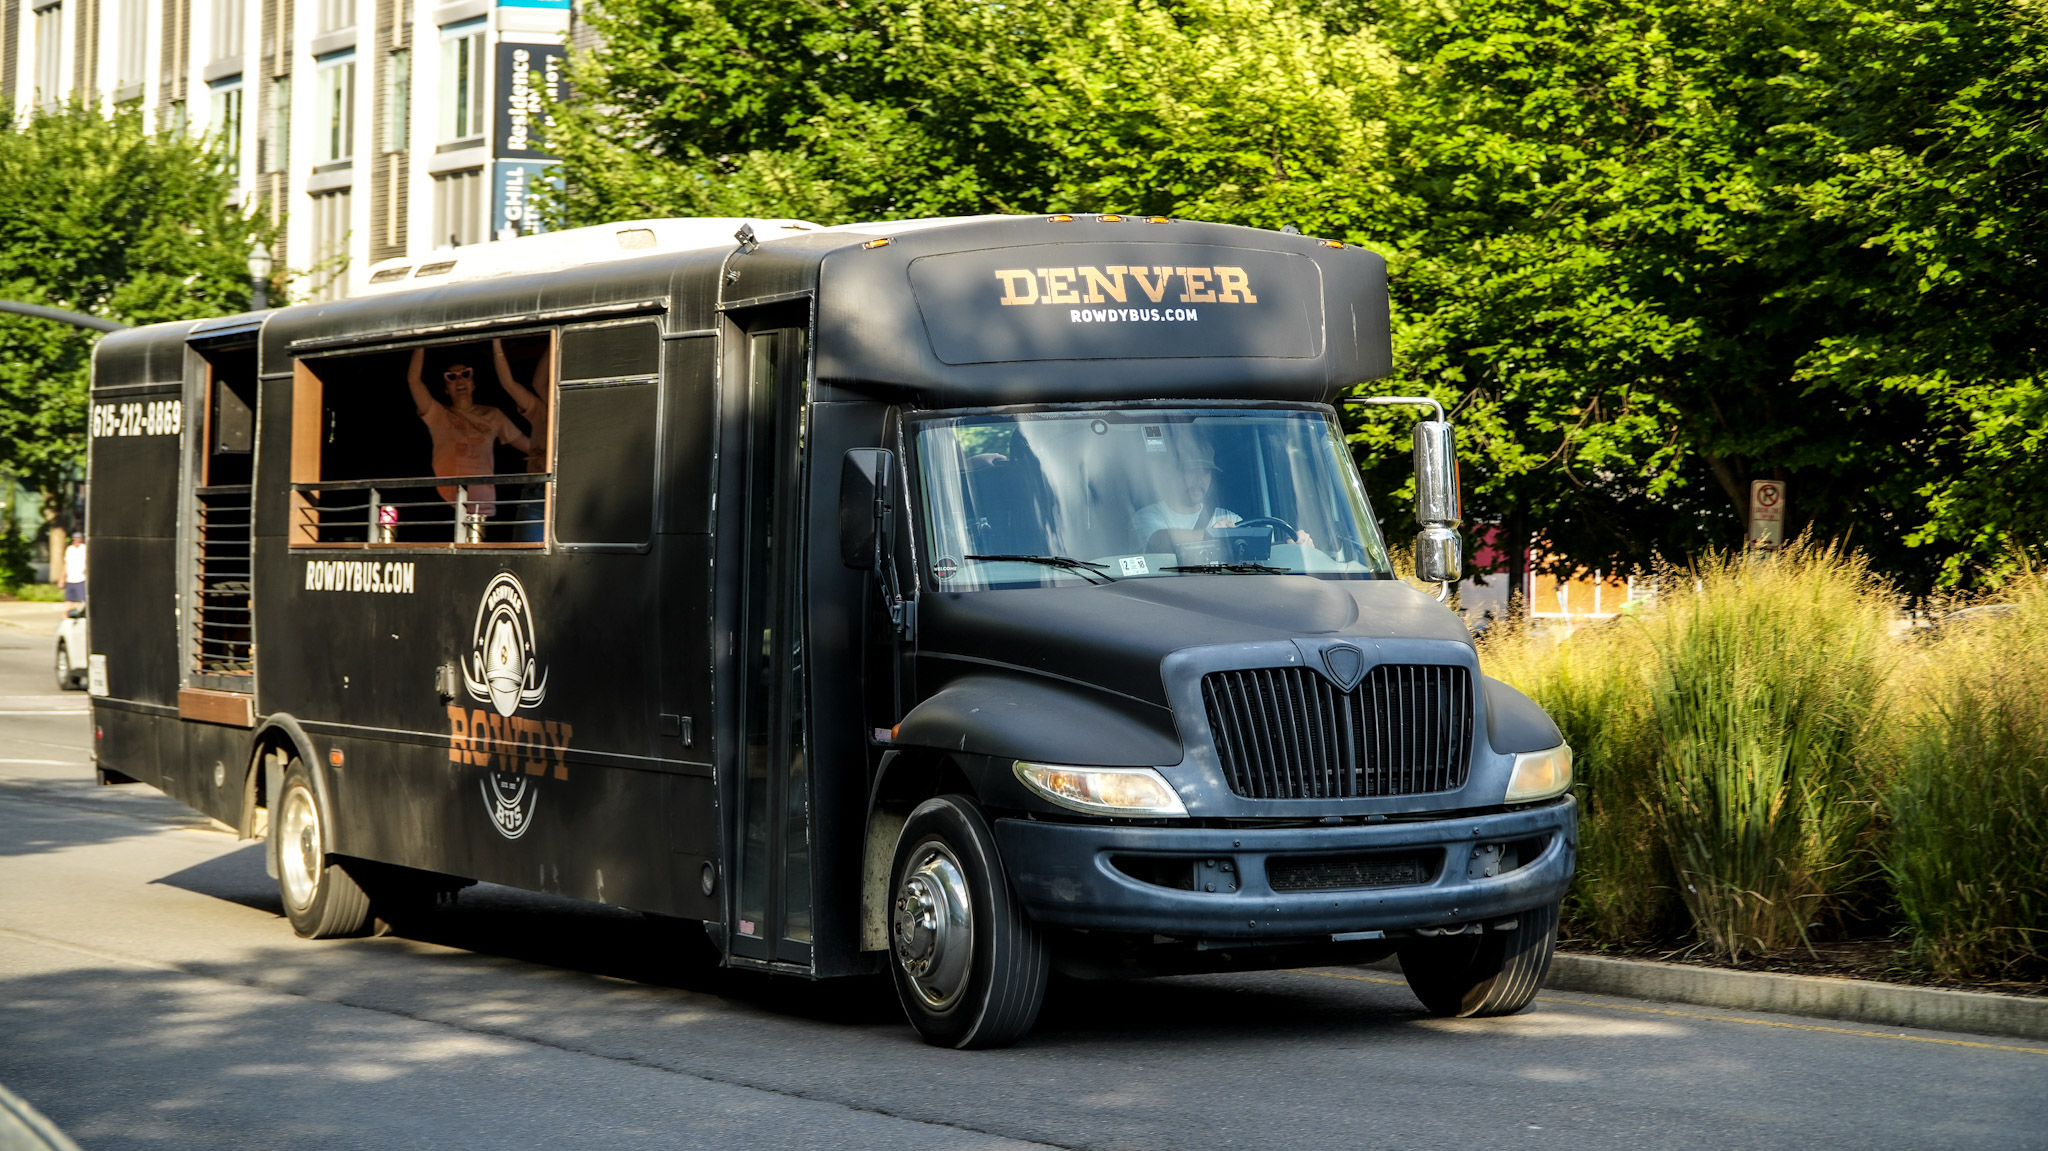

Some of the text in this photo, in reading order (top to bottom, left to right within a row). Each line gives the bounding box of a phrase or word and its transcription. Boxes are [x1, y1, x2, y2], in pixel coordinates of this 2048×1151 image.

[508, 49, 530, 150] Residence
[504, 166, 524, 229] GHILL
[994, 265, 1258, 306] DENVER
[1070, 308, 1199, 323] ROWDYBUS.COM
[93, 400, 182, 438] 615-212-8869
[305, 560, 415, 594] ROWDYBUS.COM
[488, 585, 522, 614] NASHVILLE
[447, 705, 573, 781] ROWDY
[495, 800, 523, 829] BUS
